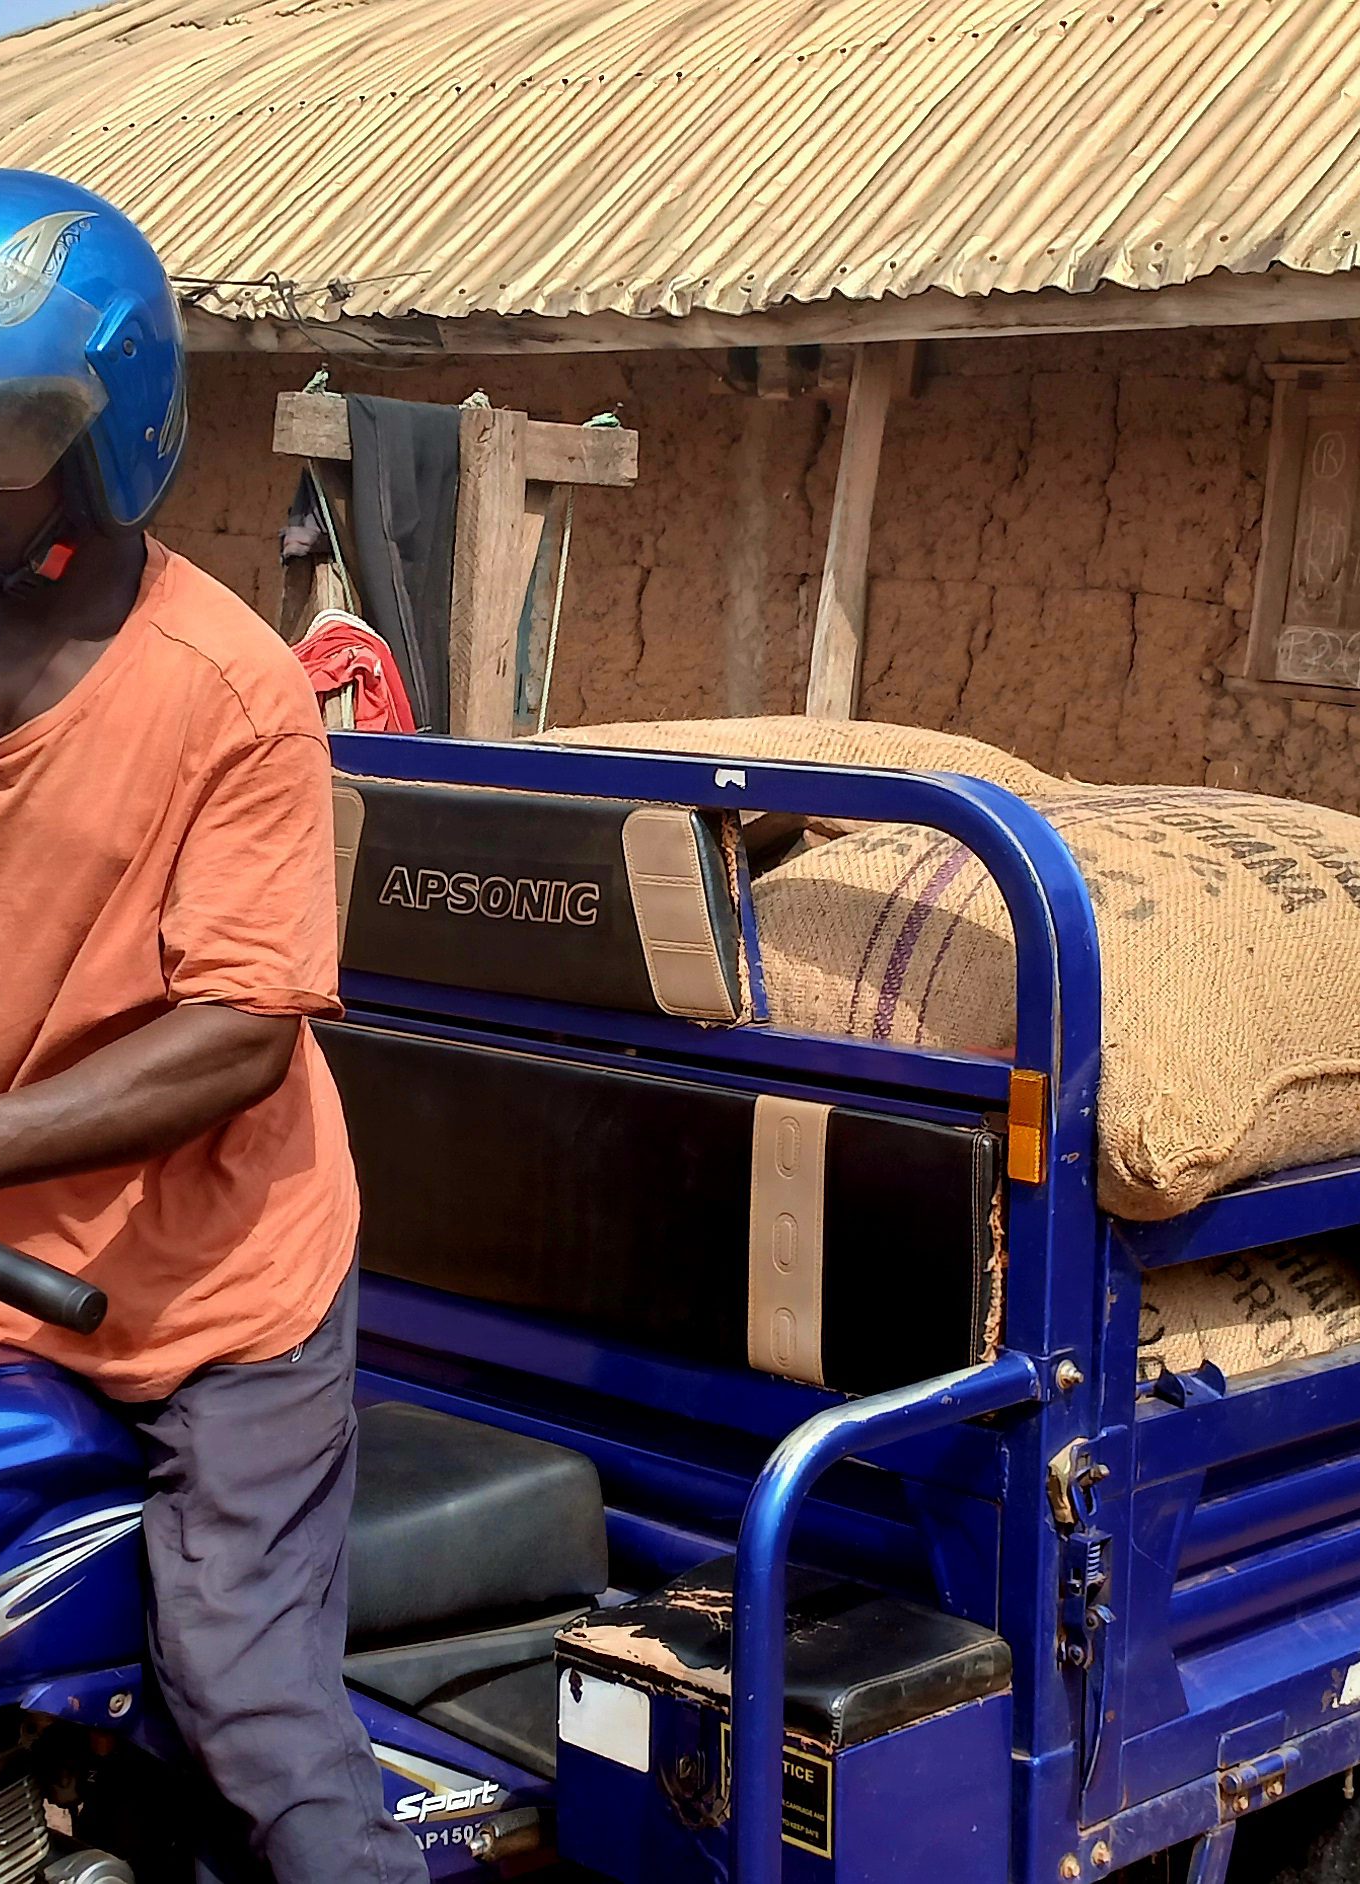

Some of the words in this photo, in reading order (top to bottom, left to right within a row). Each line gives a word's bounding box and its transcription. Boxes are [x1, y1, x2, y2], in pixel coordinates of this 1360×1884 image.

[1150, 811, 1328, 914] GHANA
[378, 865, 600, 926] APSONIC
[782, 1760, 814, 1783] TICE
[392, 1780, 500, 1823] Sport
[414, 1823, 482, 1850] P150
